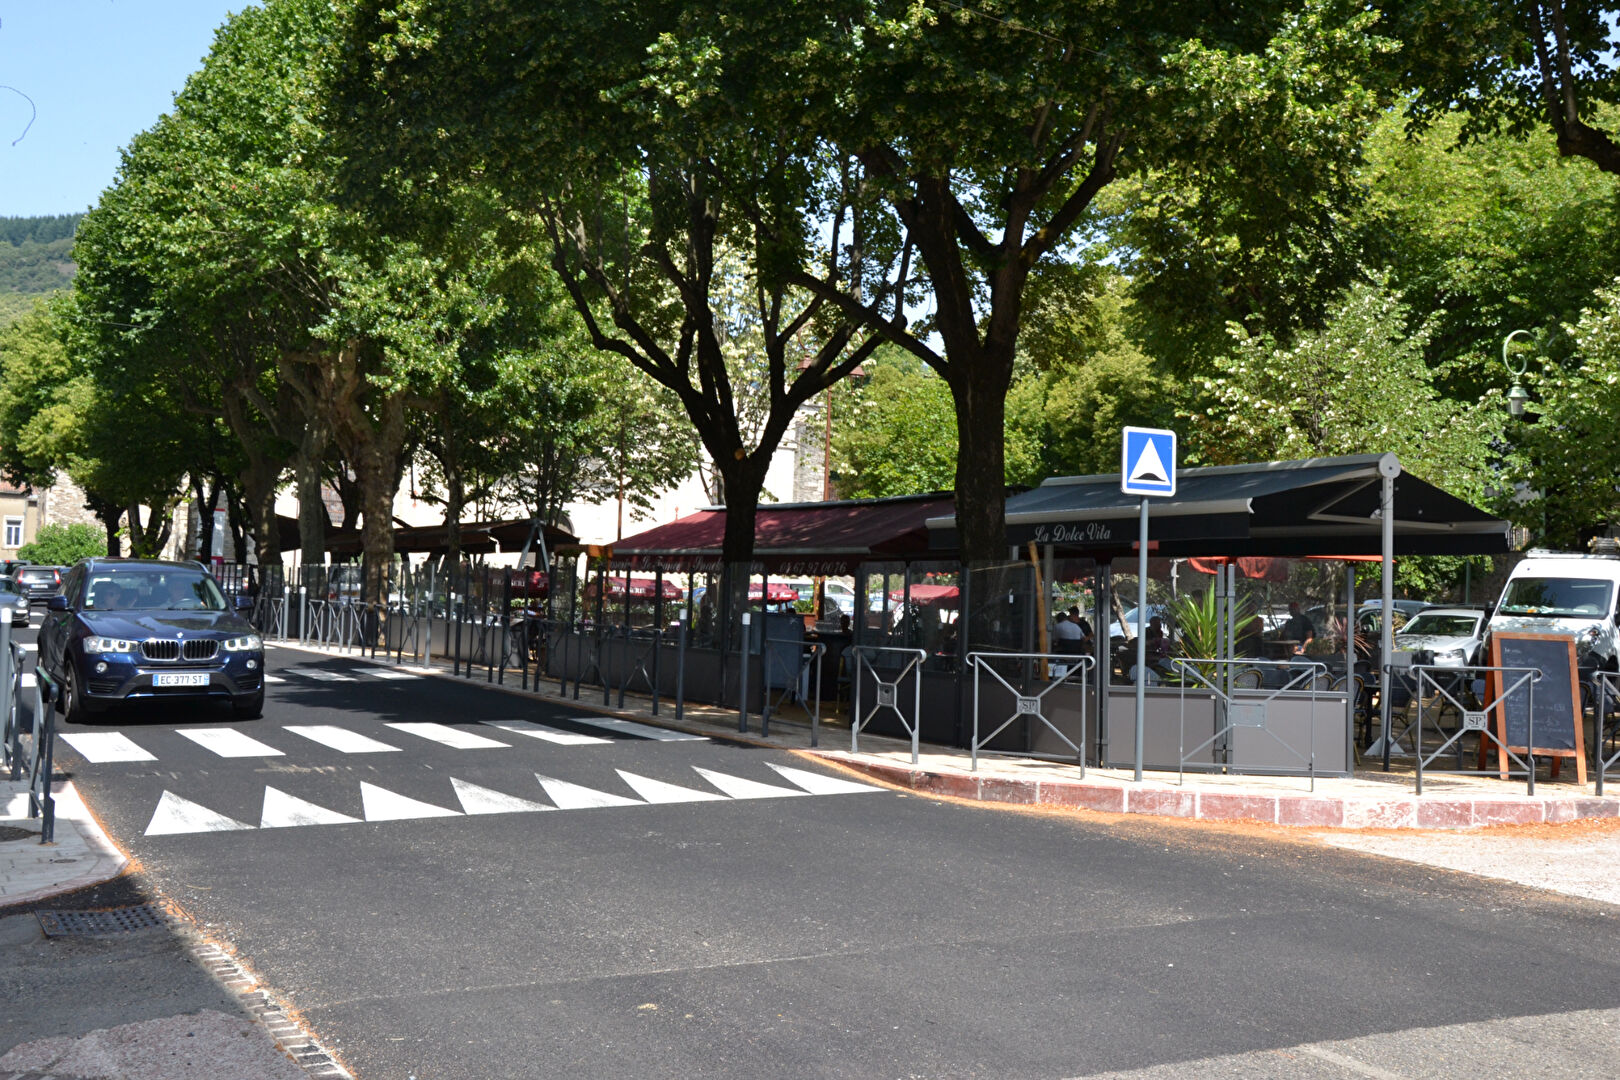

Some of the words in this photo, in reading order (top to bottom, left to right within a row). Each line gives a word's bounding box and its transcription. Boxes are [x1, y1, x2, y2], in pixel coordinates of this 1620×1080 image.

[1034, 525, 1049, 542] La
[1052, 524, 1085, 541] Dolce
[1086, 522, 1111, 540] Vita
[1468, 716, 1481, 725] SP
